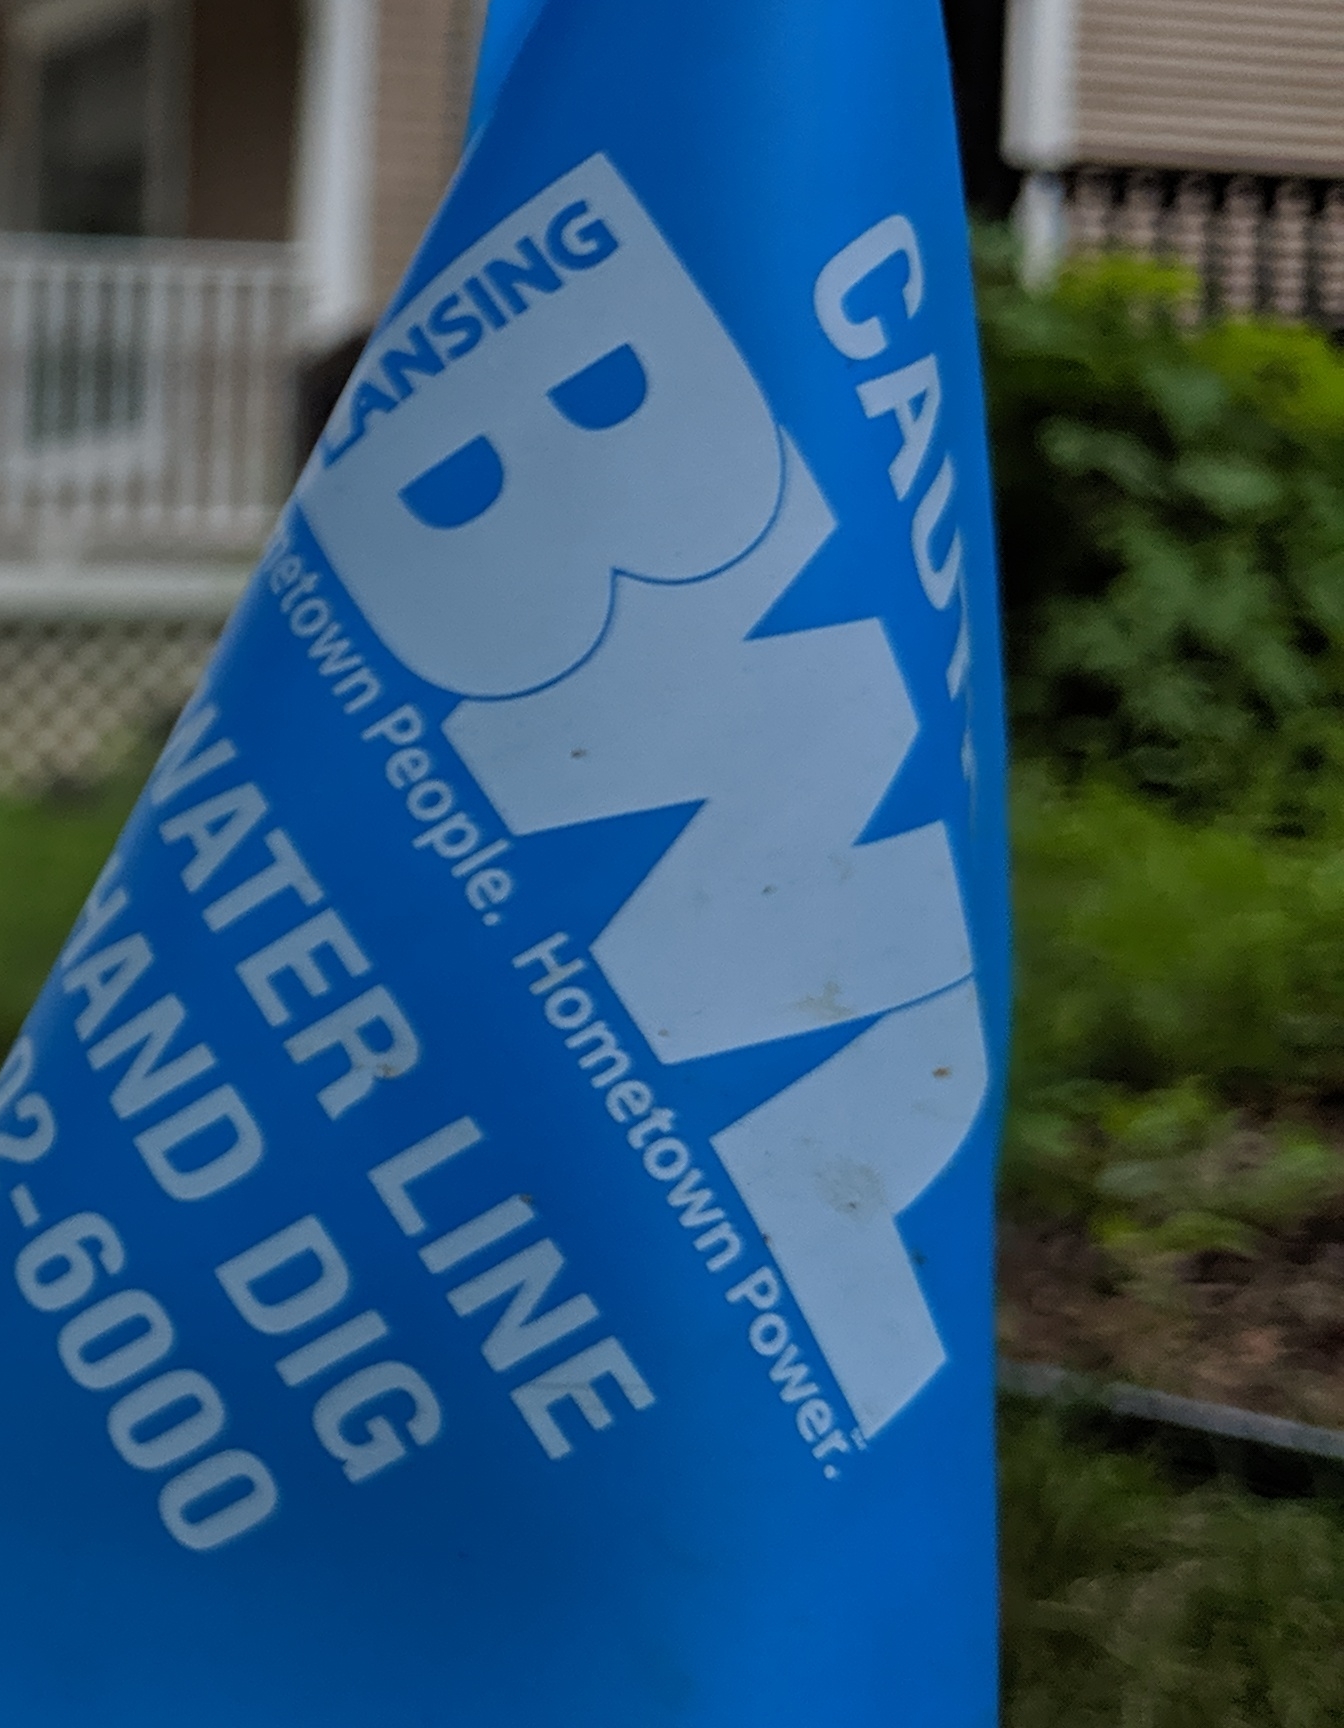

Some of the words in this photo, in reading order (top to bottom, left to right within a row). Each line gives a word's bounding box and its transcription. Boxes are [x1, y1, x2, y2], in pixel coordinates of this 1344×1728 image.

[60, 853, 263, 1201] HAND
[216, 1215, 442, 1482] DIG
[362, 704, 512, 926] People.
[512, 932, 742, 1273] Hometown
[725, 1266, 850, 1480] Power.
[369, 1116, 656, 1459] LINE
